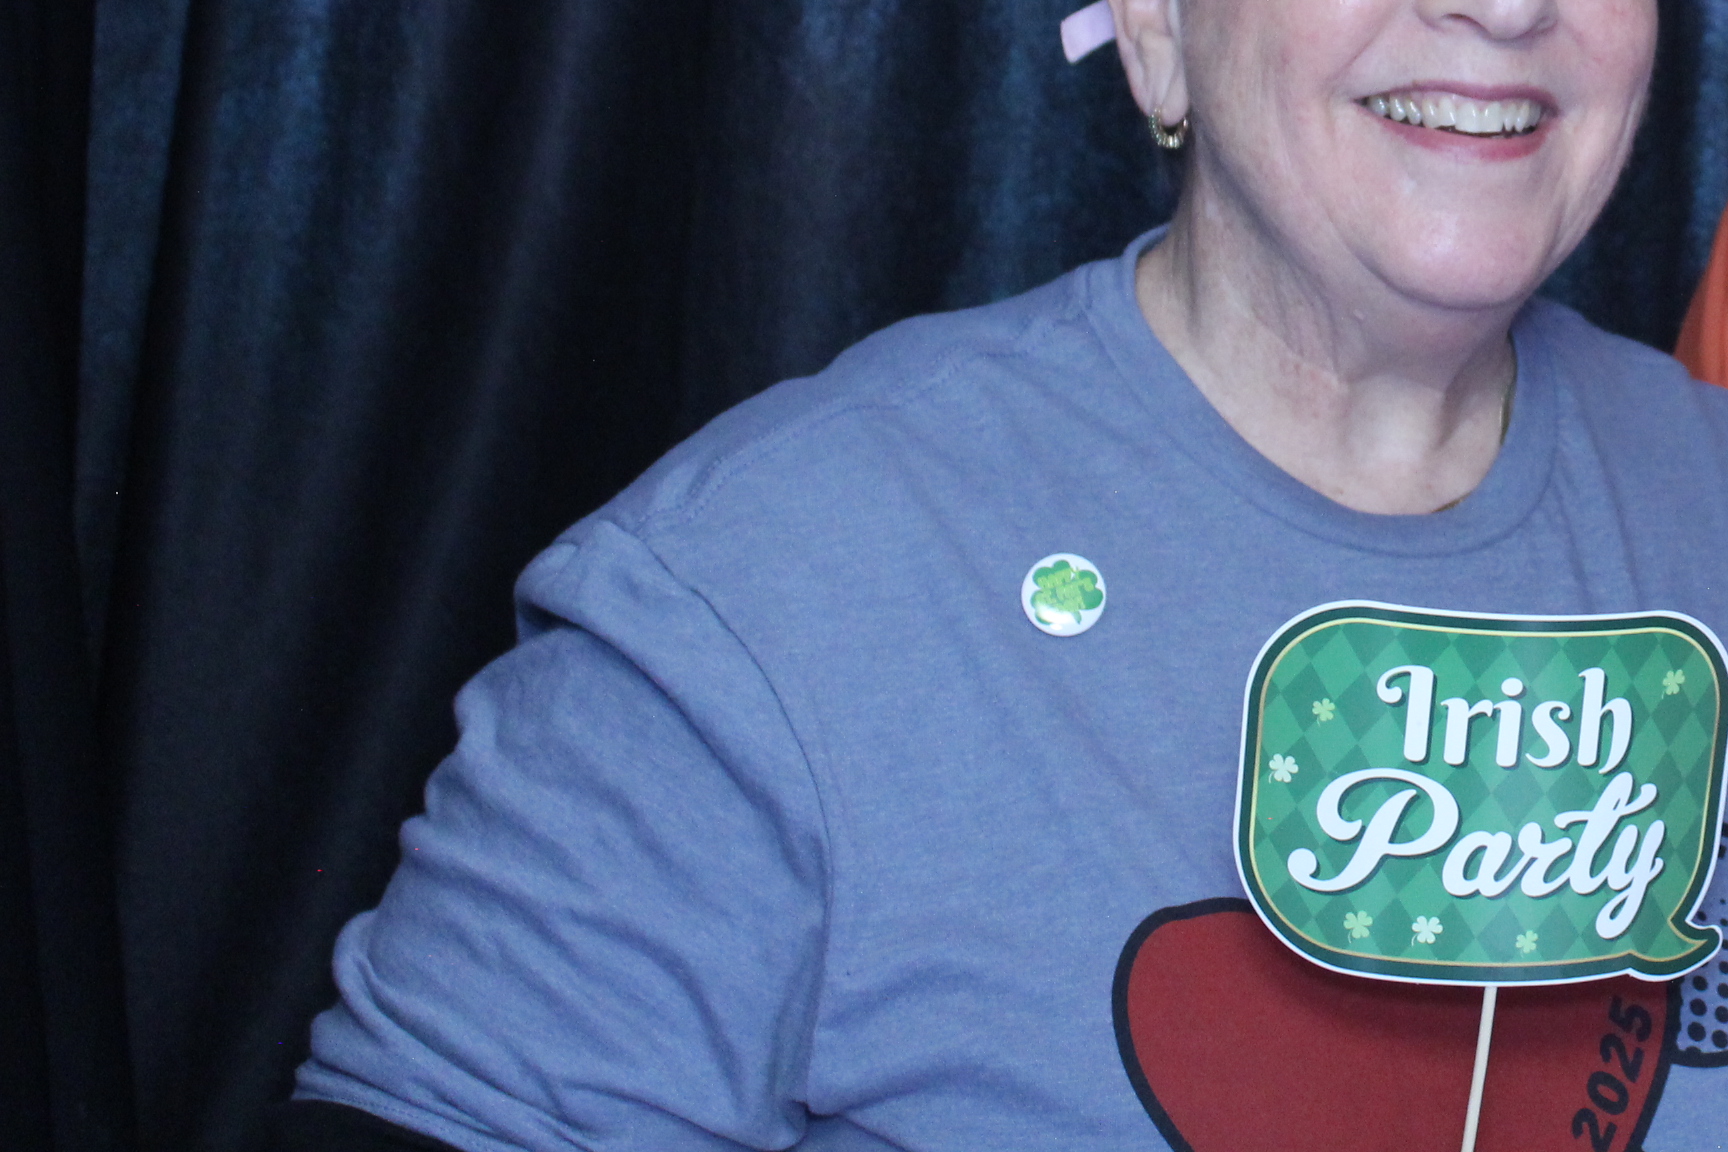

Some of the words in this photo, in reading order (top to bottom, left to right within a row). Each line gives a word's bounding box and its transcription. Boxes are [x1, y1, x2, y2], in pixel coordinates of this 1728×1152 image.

[1377, 664, 1633, 774] Irish
[1287, 767, 1665, 939] Party
[1572, 995, 1652, 1152] 2025
